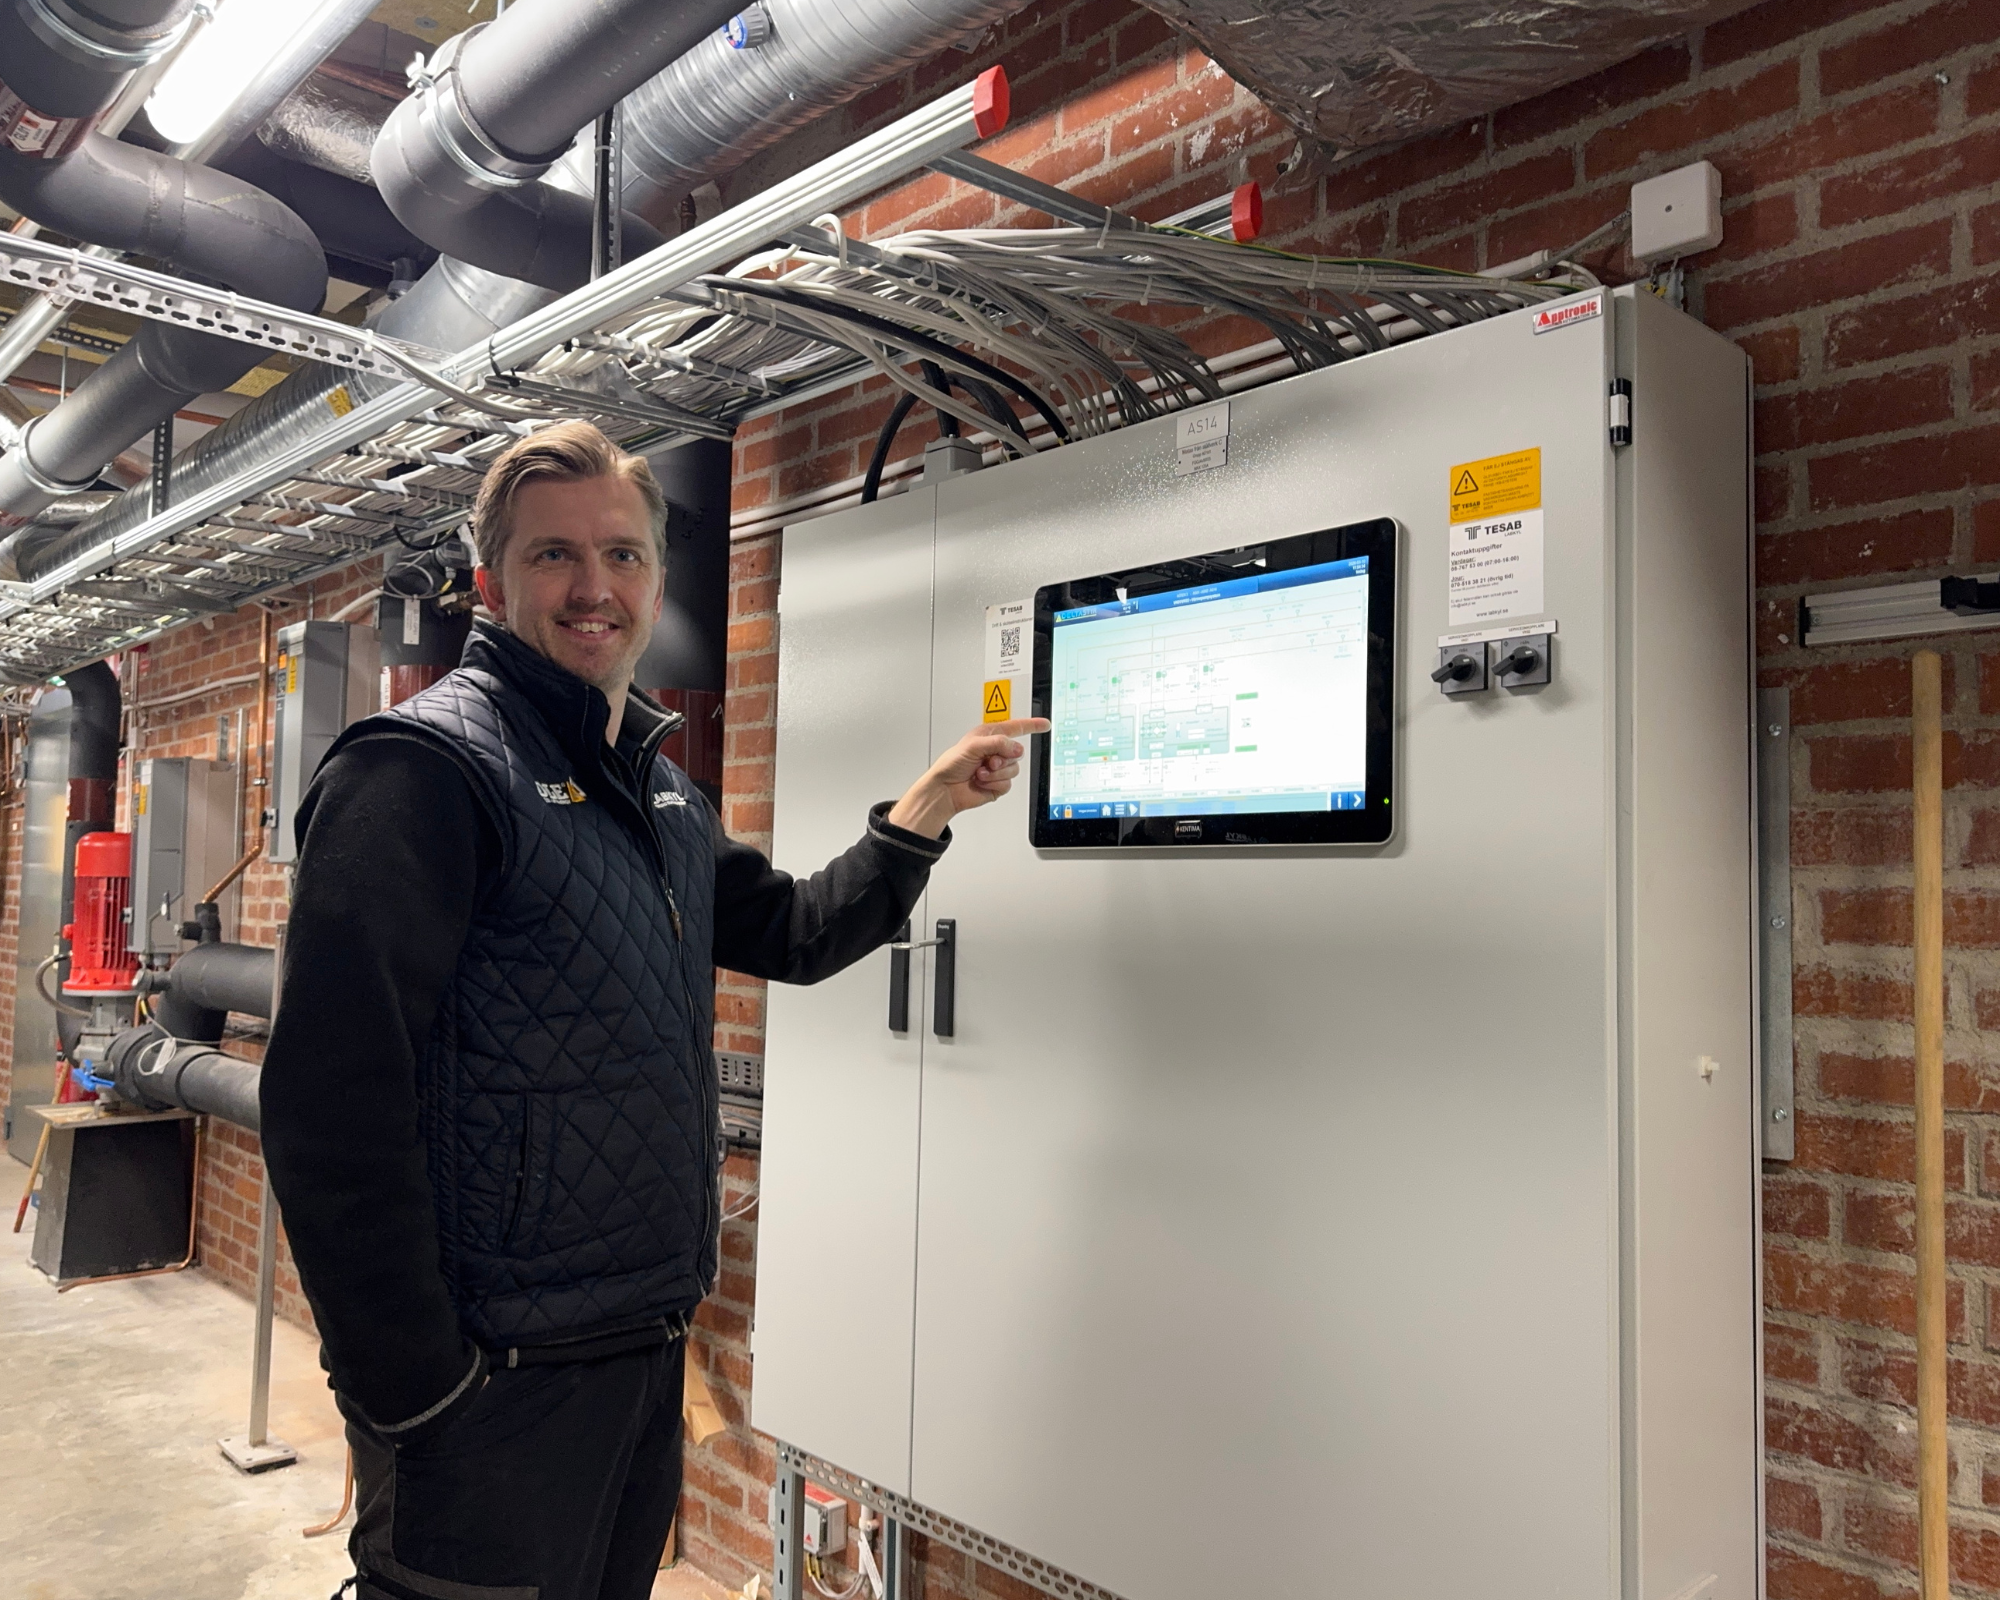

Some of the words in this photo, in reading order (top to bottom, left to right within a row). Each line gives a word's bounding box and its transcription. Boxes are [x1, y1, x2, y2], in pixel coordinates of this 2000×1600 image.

[1538, 301, 1597, 326] Apptronic
[1187, 415, 1217, 436] AS14
[1462, 501, 1480, 509] TESAB
[1485, 520, 1522, 535] TESAB
[1451, 543, 1502, 557] Kontaktuppgifter
[1007, 605, 1022, 613] TESAB
[1179, 825, 1200, 833] KENTIMA
